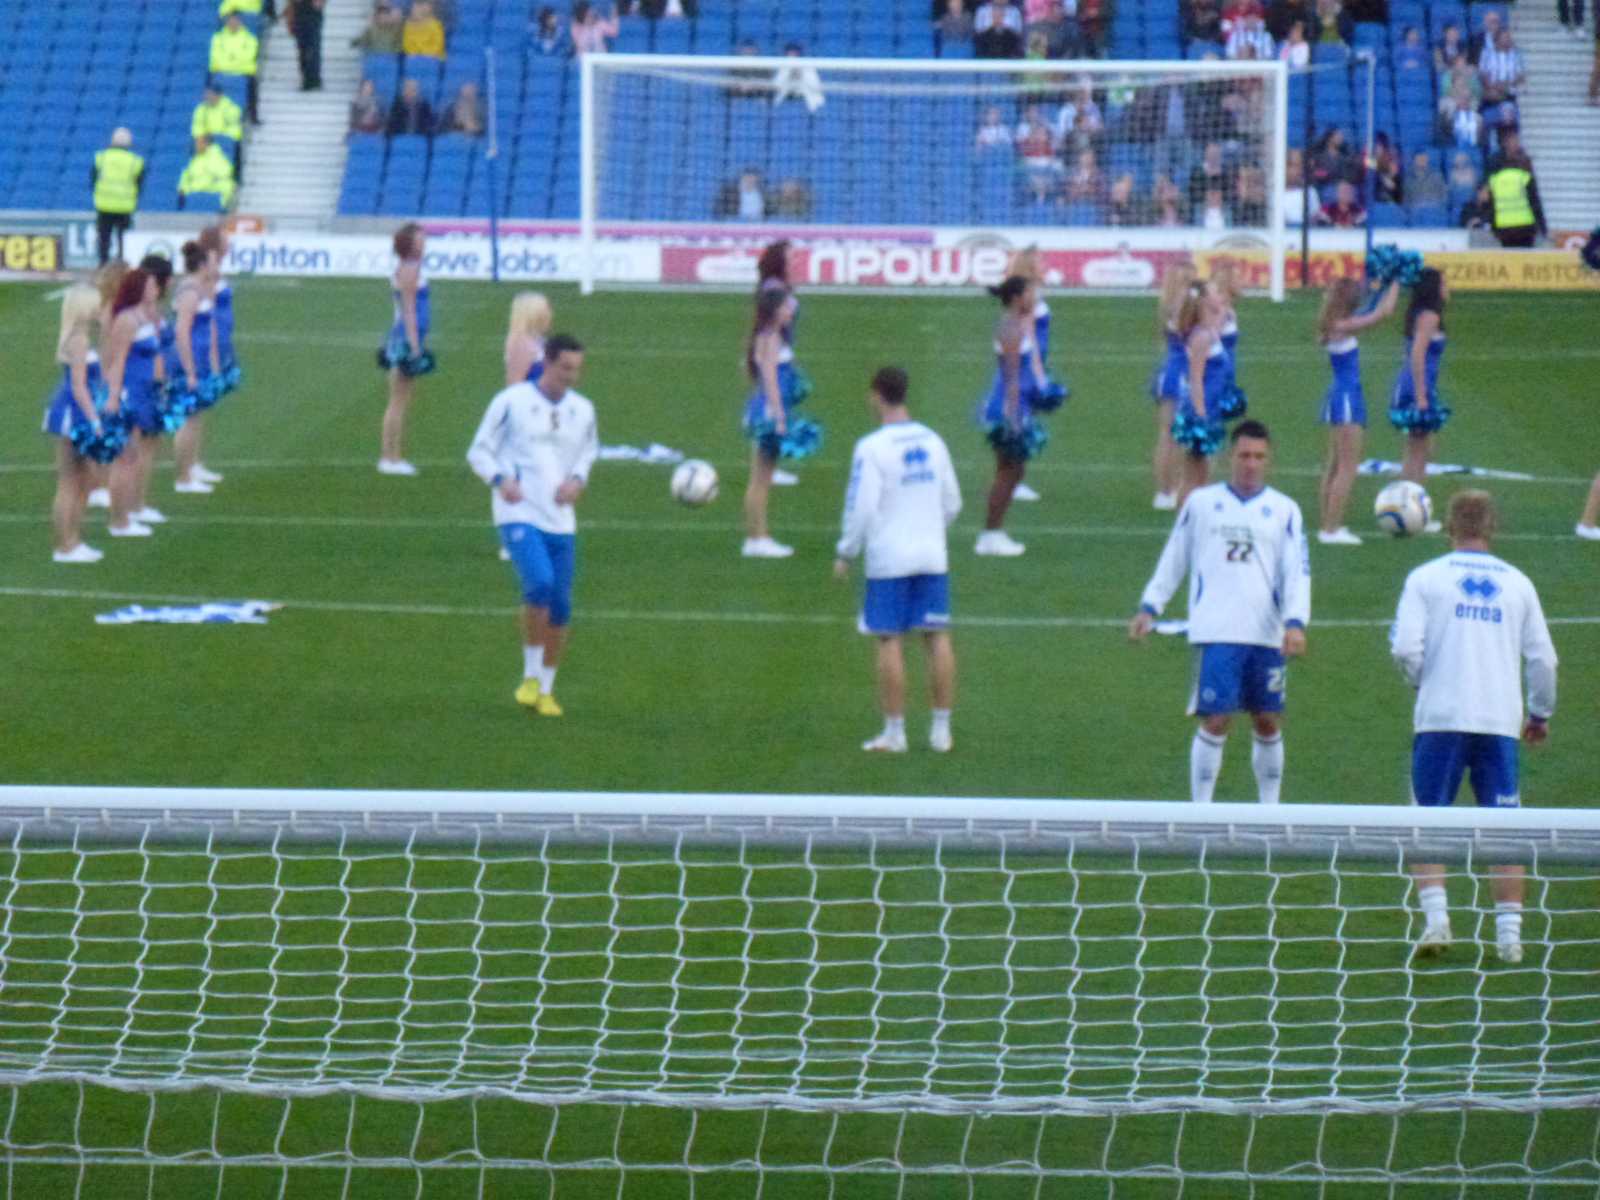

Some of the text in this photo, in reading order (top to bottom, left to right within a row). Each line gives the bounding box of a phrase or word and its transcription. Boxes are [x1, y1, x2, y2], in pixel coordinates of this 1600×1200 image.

[229, 243, 330, 272] ighton
[808, 246, 1009, 285] npowe
[1226, 540, 1255, 563] 22
[1455, 603, 1503, 624] errea
